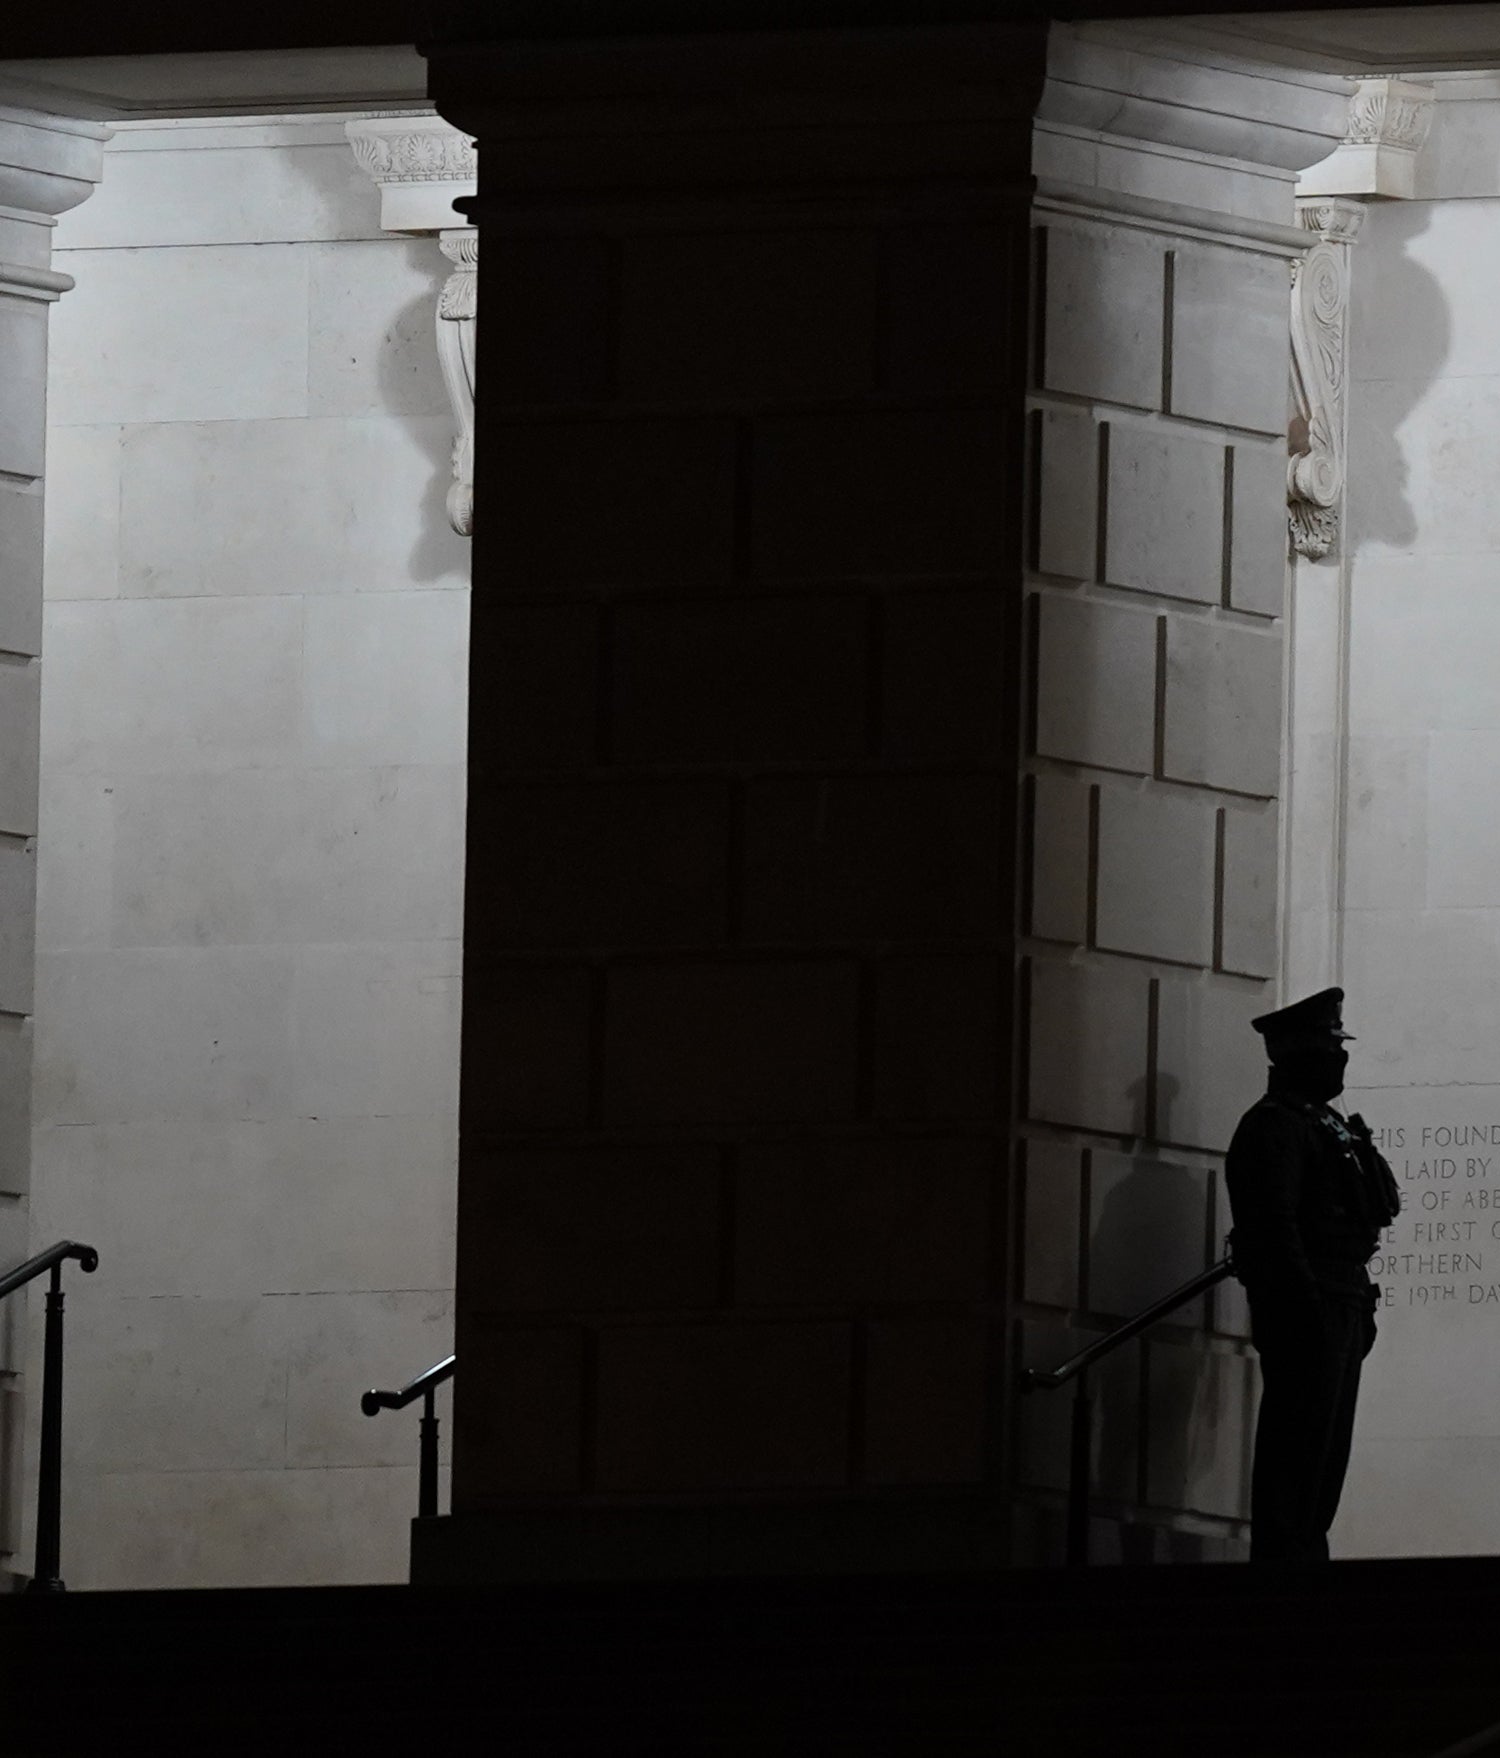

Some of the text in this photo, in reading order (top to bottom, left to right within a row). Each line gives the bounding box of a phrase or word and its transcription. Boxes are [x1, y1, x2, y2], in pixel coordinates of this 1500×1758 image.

[1371, 1127, 1406, 1148] HIS
[1404, 1158, 1456, 1180] LAID
[1466, 1157, 1492, 1178] BY
[1421, 1190, 1451, 1211] OF
[1414, 1220, 1478, 1243] FIRST
[1367, 1253, 1483, 1276] ORTHERN
[1408, 1286, 1456, 1307] 19TH
